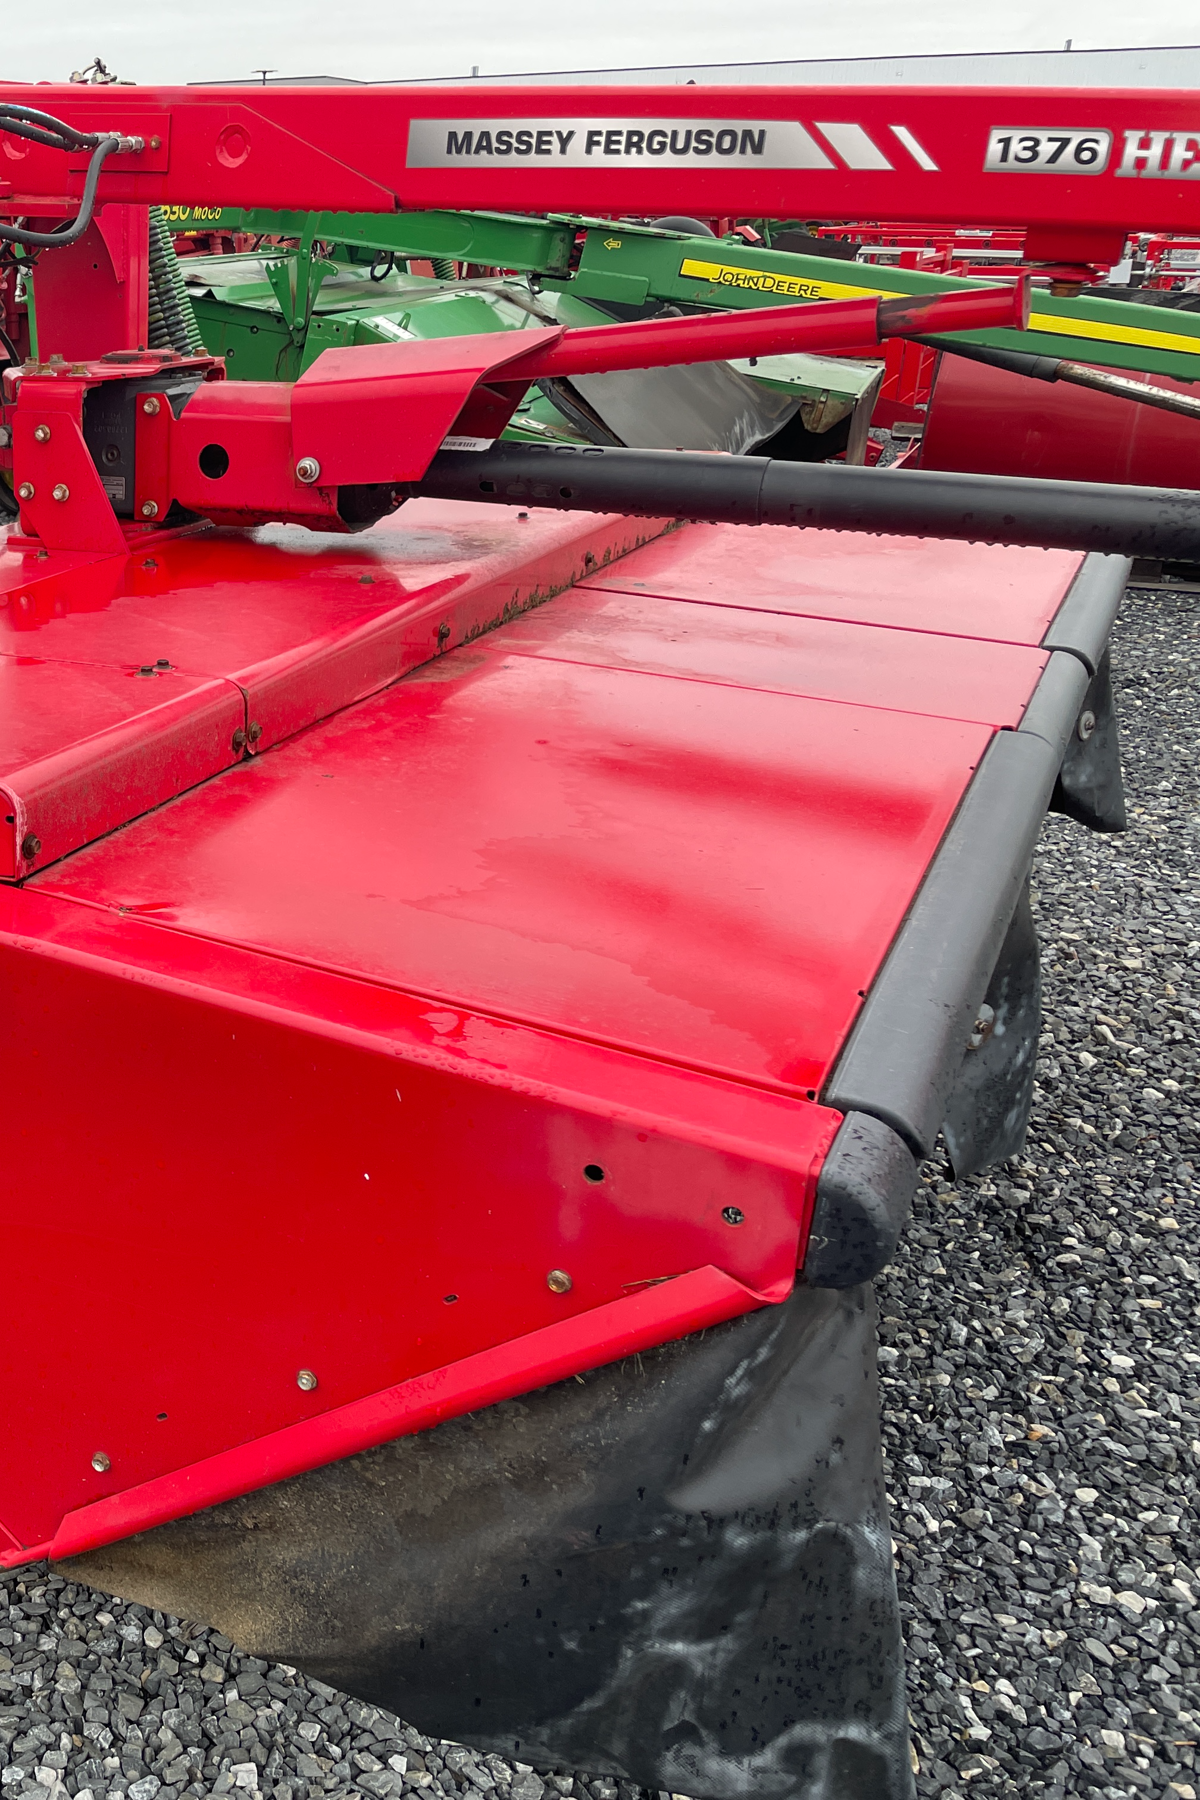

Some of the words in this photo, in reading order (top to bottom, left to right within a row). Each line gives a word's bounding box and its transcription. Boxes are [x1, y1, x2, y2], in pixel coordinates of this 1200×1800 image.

[446, 130, 576, 155] MASSEY
[585, 129, 767, 155] FERGUSON
[996, 136, 1101, 165] 1376
